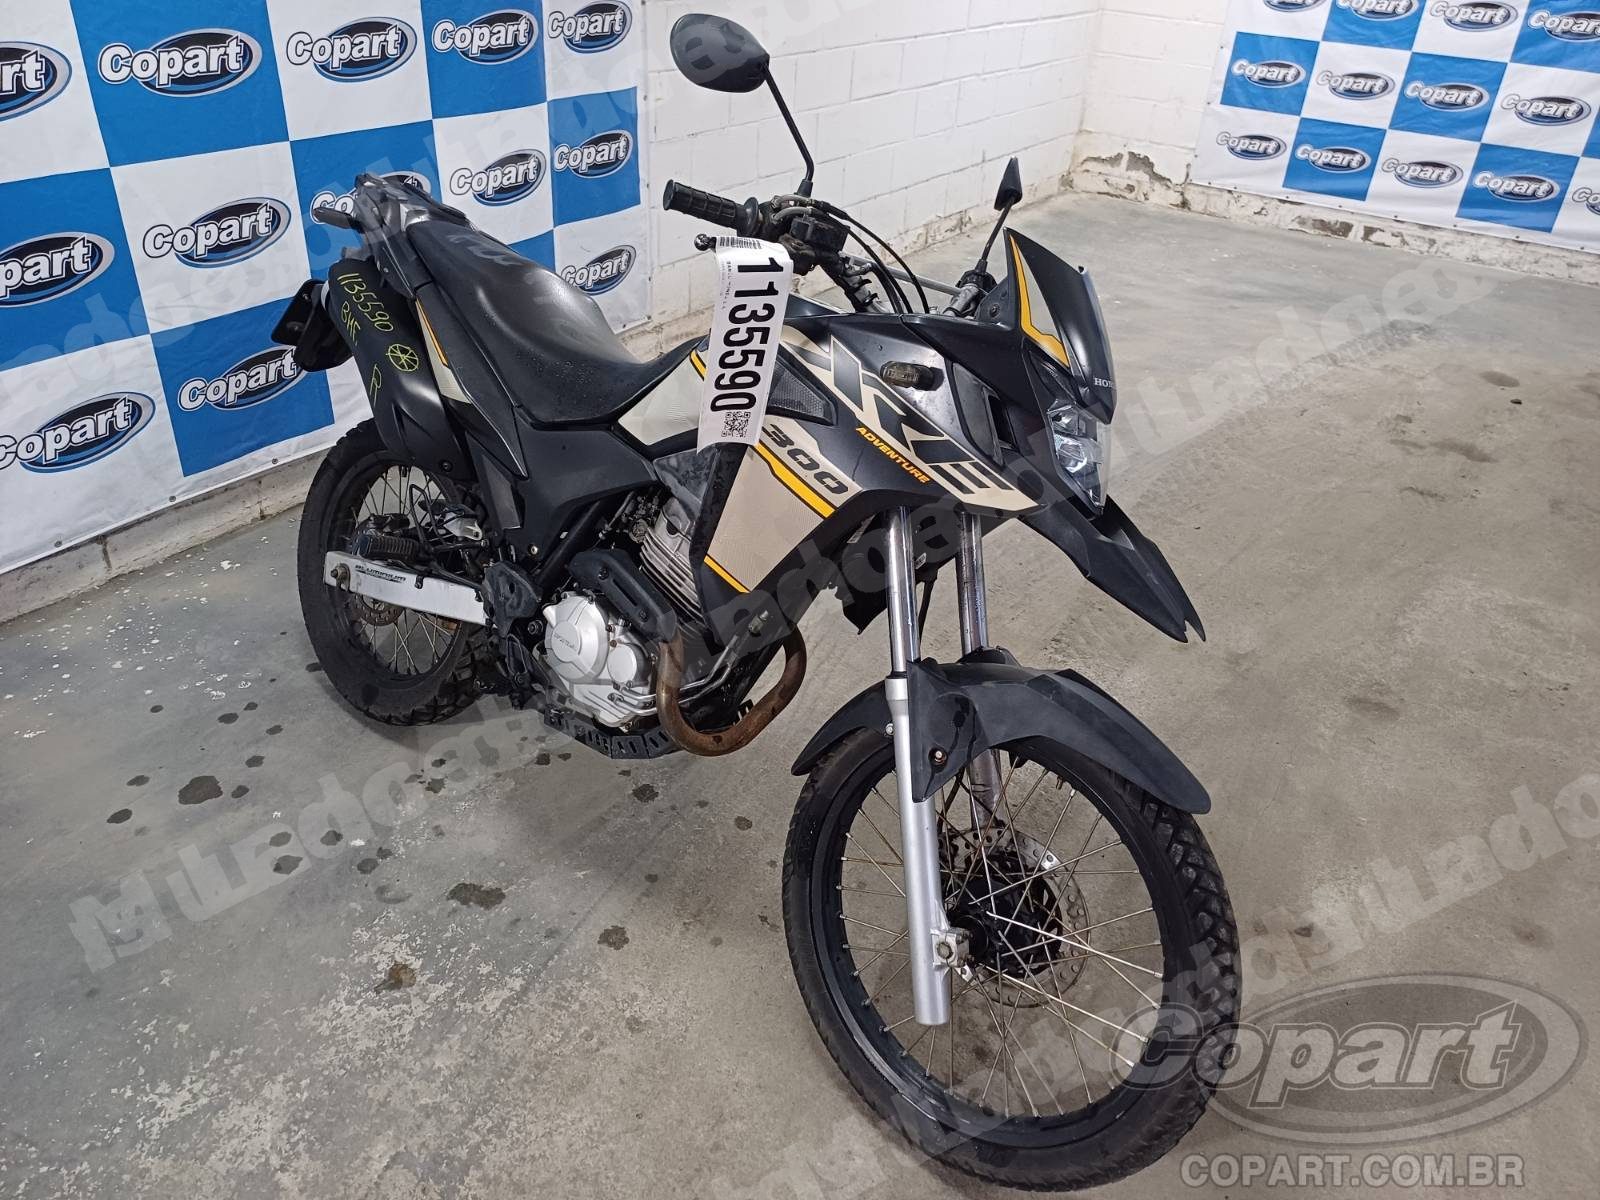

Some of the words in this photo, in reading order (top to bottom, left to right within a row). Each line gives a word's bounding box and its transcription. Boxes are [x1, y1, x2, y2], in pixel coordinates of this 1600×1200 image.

[549, 5, 625, 44] Copart
[1430, 0, 1508, 25] Copart
[287, 18, 404, 71] Copart
[432, 14, 530, 58] Copart
[98, 33, 245, 87] Copart
[1231, 58, 1300, 83] Copart
[1316, 70, 1388, 93] Copart
[1405, 80, 1482, 107] Copart
[1500, 93, 1582, 120] Copart
[553, 133, 628, 173] Copart
[1216, 131, 1279, 155] Copart
[1295, 144, 1363, 170] Copart
[450, 153, 539, 198] Copart
[1381, 157, 1453, 184] Copart
[1473, 170, 1554, 200] Copart
[142, 201, 276, 259] Copart
[560, 248, 631, 289] Copart
[337, 272, 394, 332] 1135590
[709, 257, 784, 412] 1135590
[177, 347, 297, 411] Copart
[762, 424, 849, 495] 300
[855, 425, 930, 484] ADVENTURE
